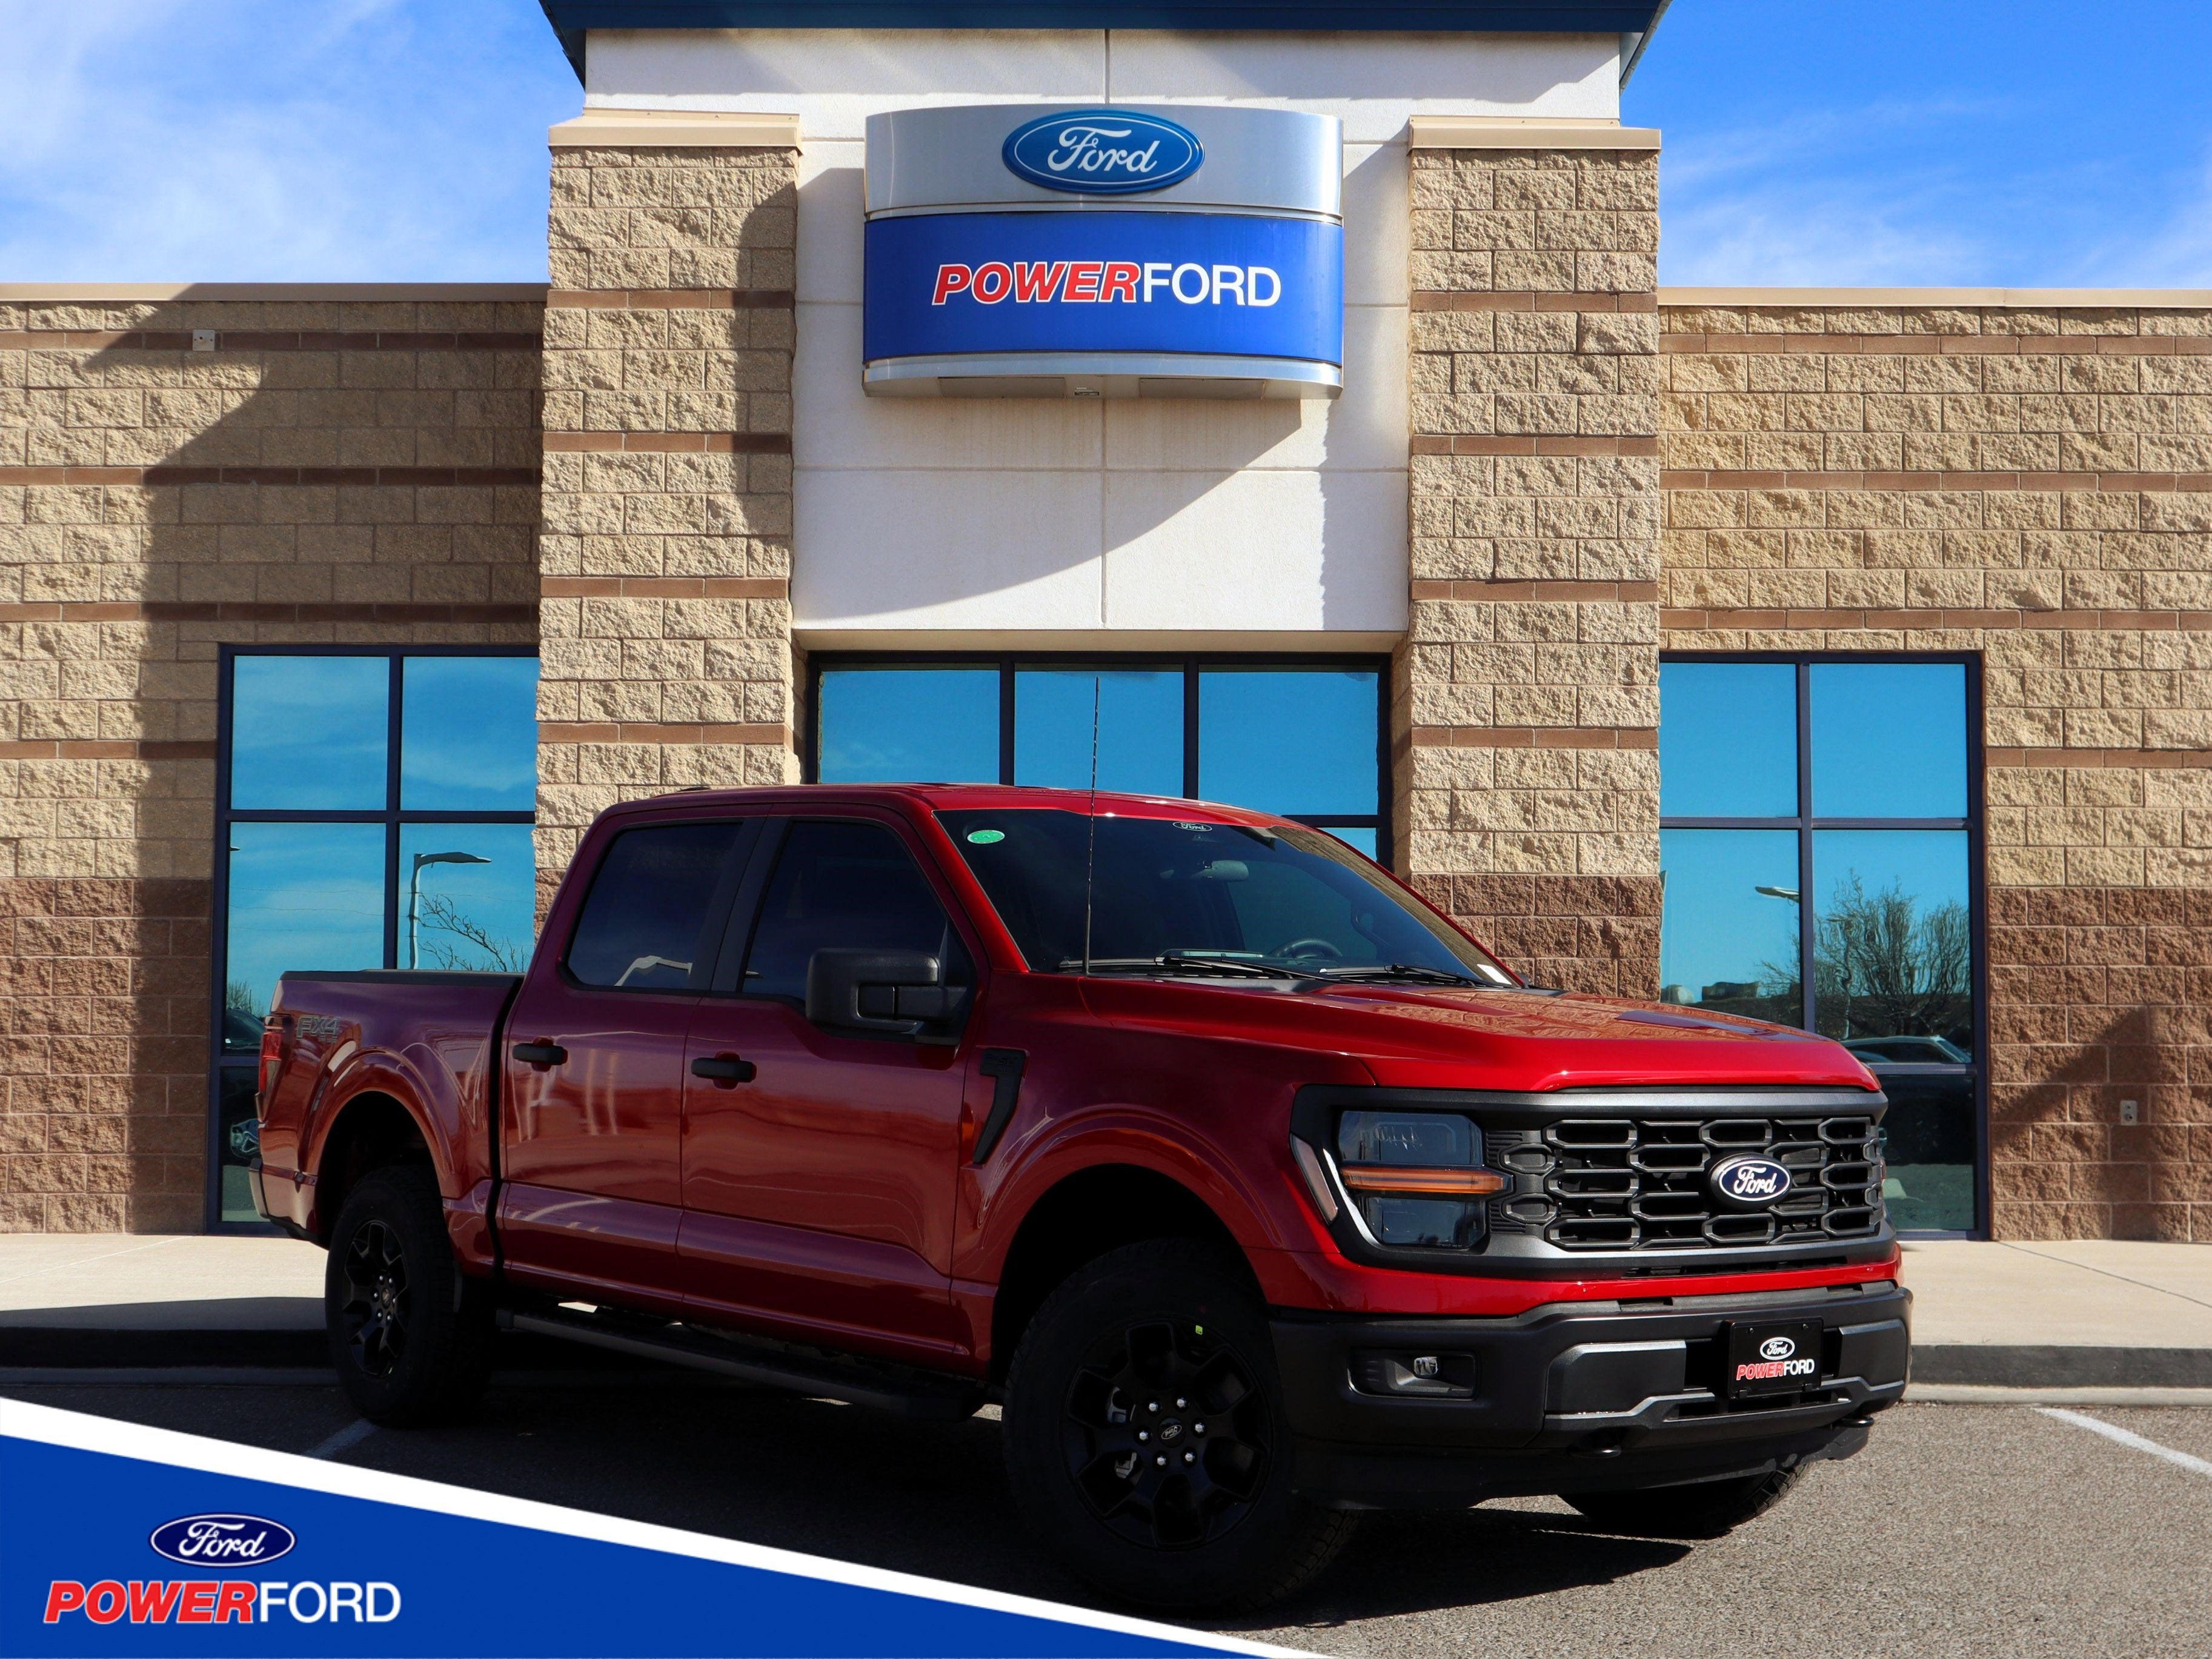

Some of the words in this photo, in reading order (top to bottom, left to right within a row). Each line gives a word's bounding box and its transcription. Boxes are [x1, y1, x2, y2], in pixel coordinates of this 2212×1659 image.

[1047, 125, 1161, 173] Ford
[931, 261, 1281, 306] POWERFORD
[296, 1014, 340, 1040] FX4
[1733, 1166, 1778, 1194] Ford
[1767, 1341, 1789, 1355] Ford
[1736, 1358, 1815, 1381] POWERFORD
